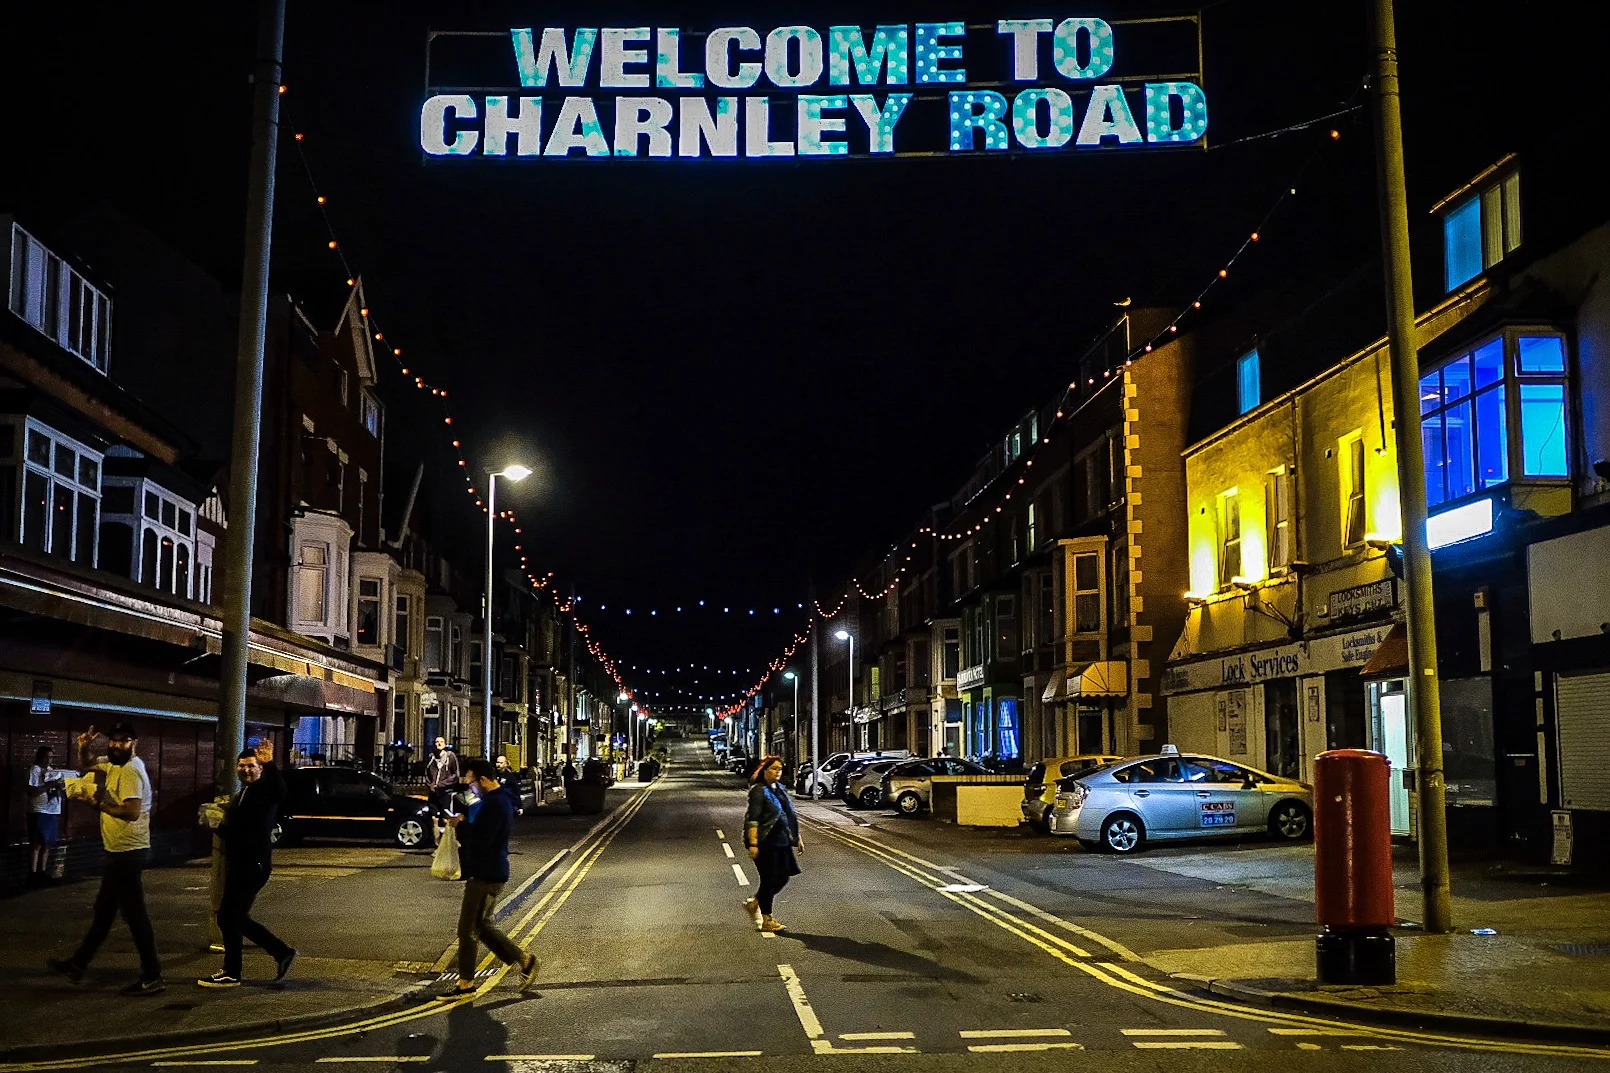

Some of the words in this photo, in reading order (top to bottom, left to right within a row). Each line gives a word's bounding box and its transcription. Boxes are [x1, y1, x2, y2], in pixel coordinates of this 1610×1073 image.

[511, 22, 967, 90] WELCOME
[998, 17, 1115, 82] TO
[420, 92, 913, 158] CHARNLEY
[949, 82, 1209, 152] ROAD
[1337, 584, 1382, 604] LOCKSMITHS
[1341, 632, 1376, 650] Locksmiths
[1375, 631, 1383, 643] &
[1221, 656, 1245, 682] Lock
[1250, 650, 1299, 678] Services
